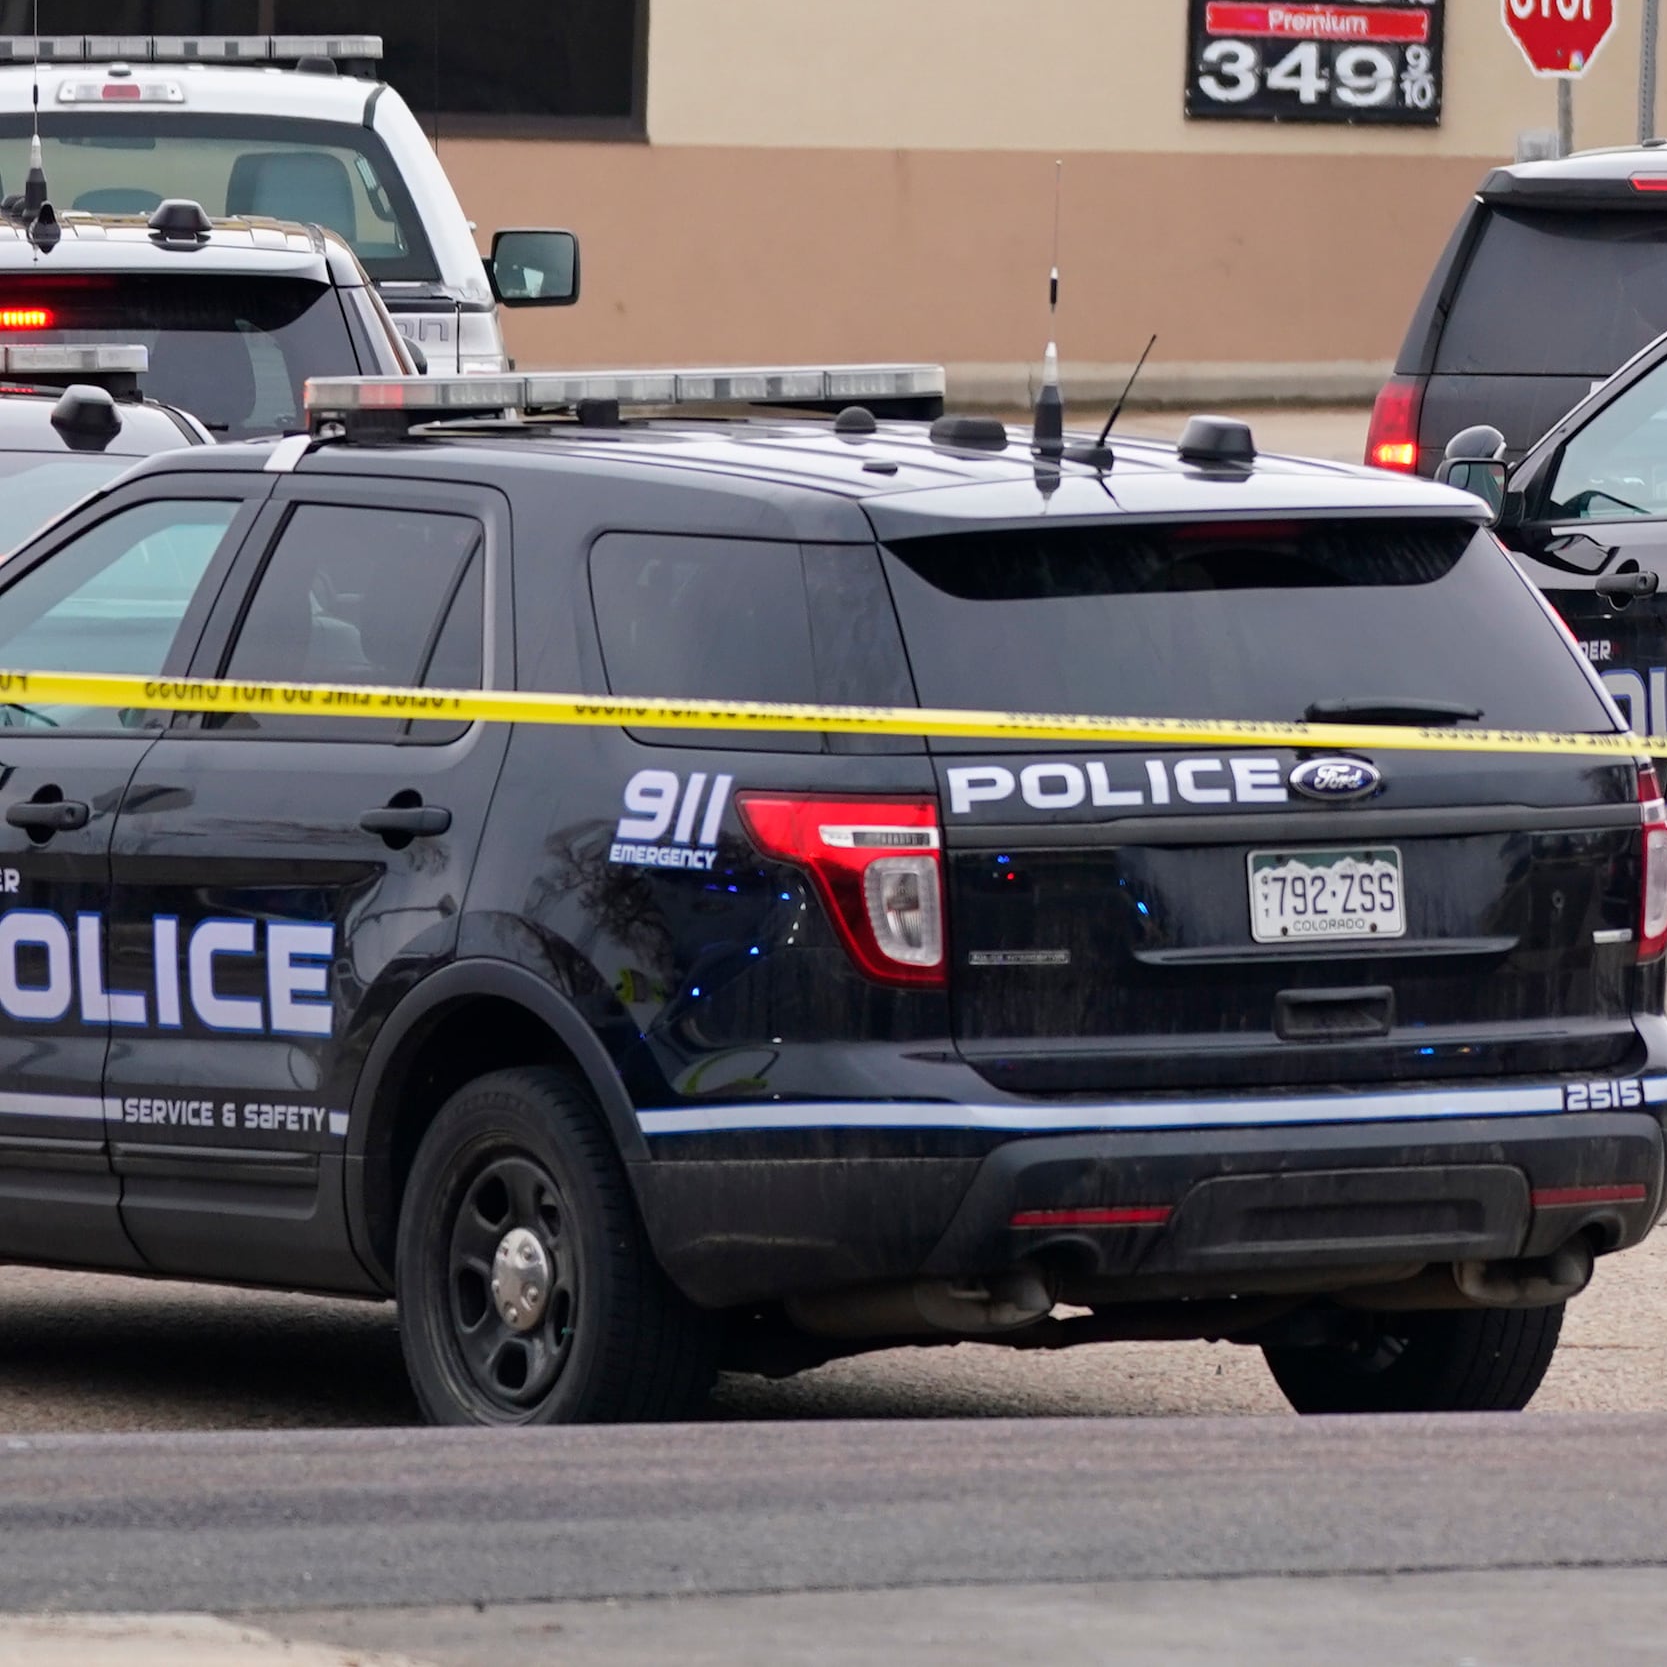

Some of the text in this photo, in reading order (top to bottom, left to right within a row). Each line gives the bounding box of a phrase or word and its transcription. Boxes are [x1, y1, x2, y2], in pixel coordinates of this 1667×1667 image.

[1268, 10, 1369, 36] Premium
[1199, 39, 1395, 107] 349
[946, 758, 1363, 814] POLICE Ford
[617, 769, 734, 848] 911
[609, 844, 719, 871] EMERGENCY
[1293, 918, 1366, 932] COLORADO
[0, 908, 336, 1037] OLICE
[1565, 1079, 1642, 1111] 2515
[124, 1096, 215, 1129] SERVICE
[221, 1101, 237, 1129] &
